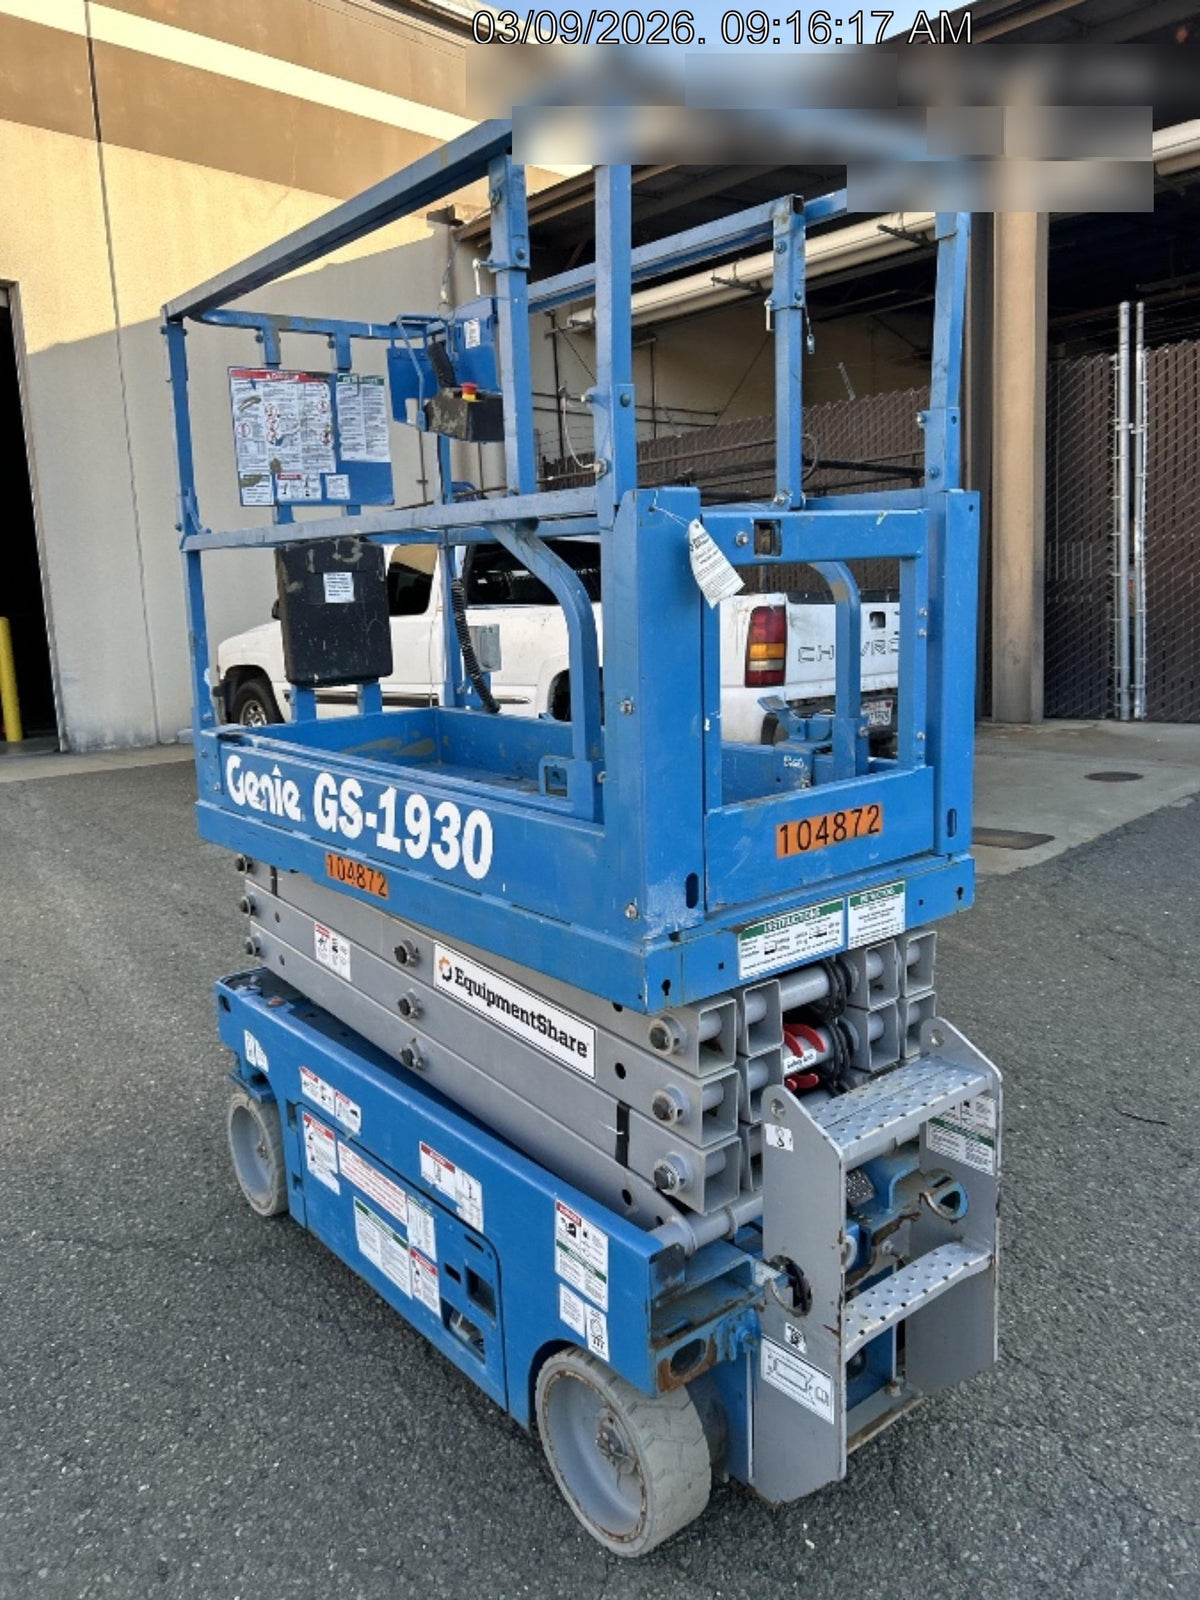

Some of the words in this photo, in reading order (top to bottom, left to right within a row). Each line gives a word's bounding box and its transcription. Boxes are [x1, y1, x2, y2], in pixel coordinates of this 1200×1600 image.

[226, 754, 302, 823] Genie
[313, 771, 494, 881] GS-1930
[780, 804, 880, 854] 104872
[327, 852, 387, 898] 104872
[454, 966, 588, 1059] EquipmentShare
